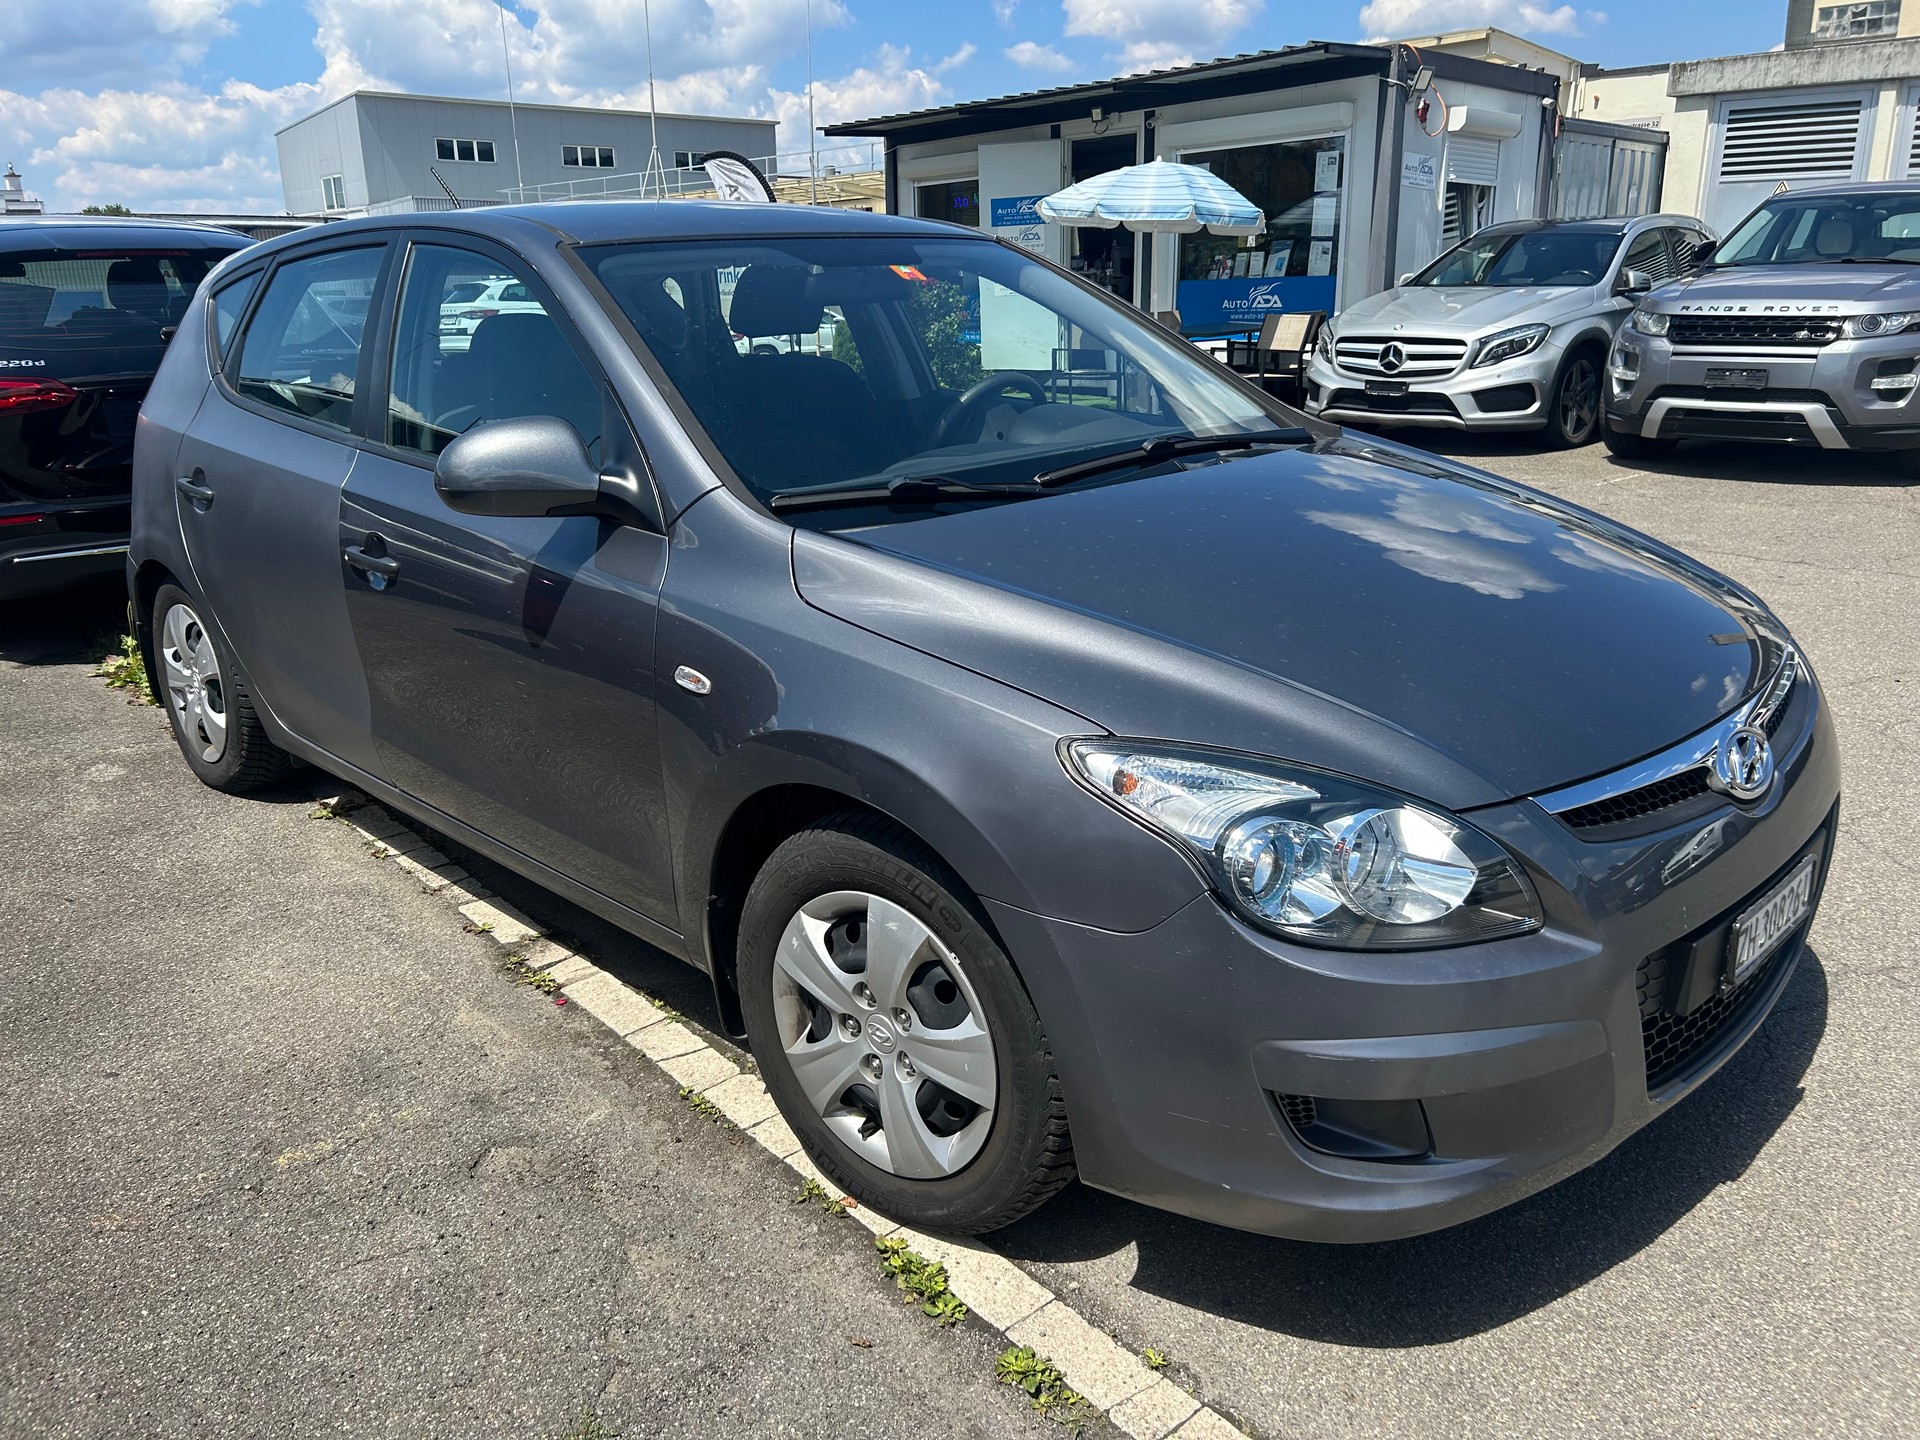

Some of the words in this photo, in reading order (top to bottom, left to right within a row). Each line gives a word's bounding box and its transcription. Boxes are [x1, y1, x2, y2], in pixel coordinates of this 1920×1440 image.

[1021, 232, 1041, 241] ADA
[1222, 299, 1249, 309] AUTO
[1251, 294, 1283, 308] ADA
